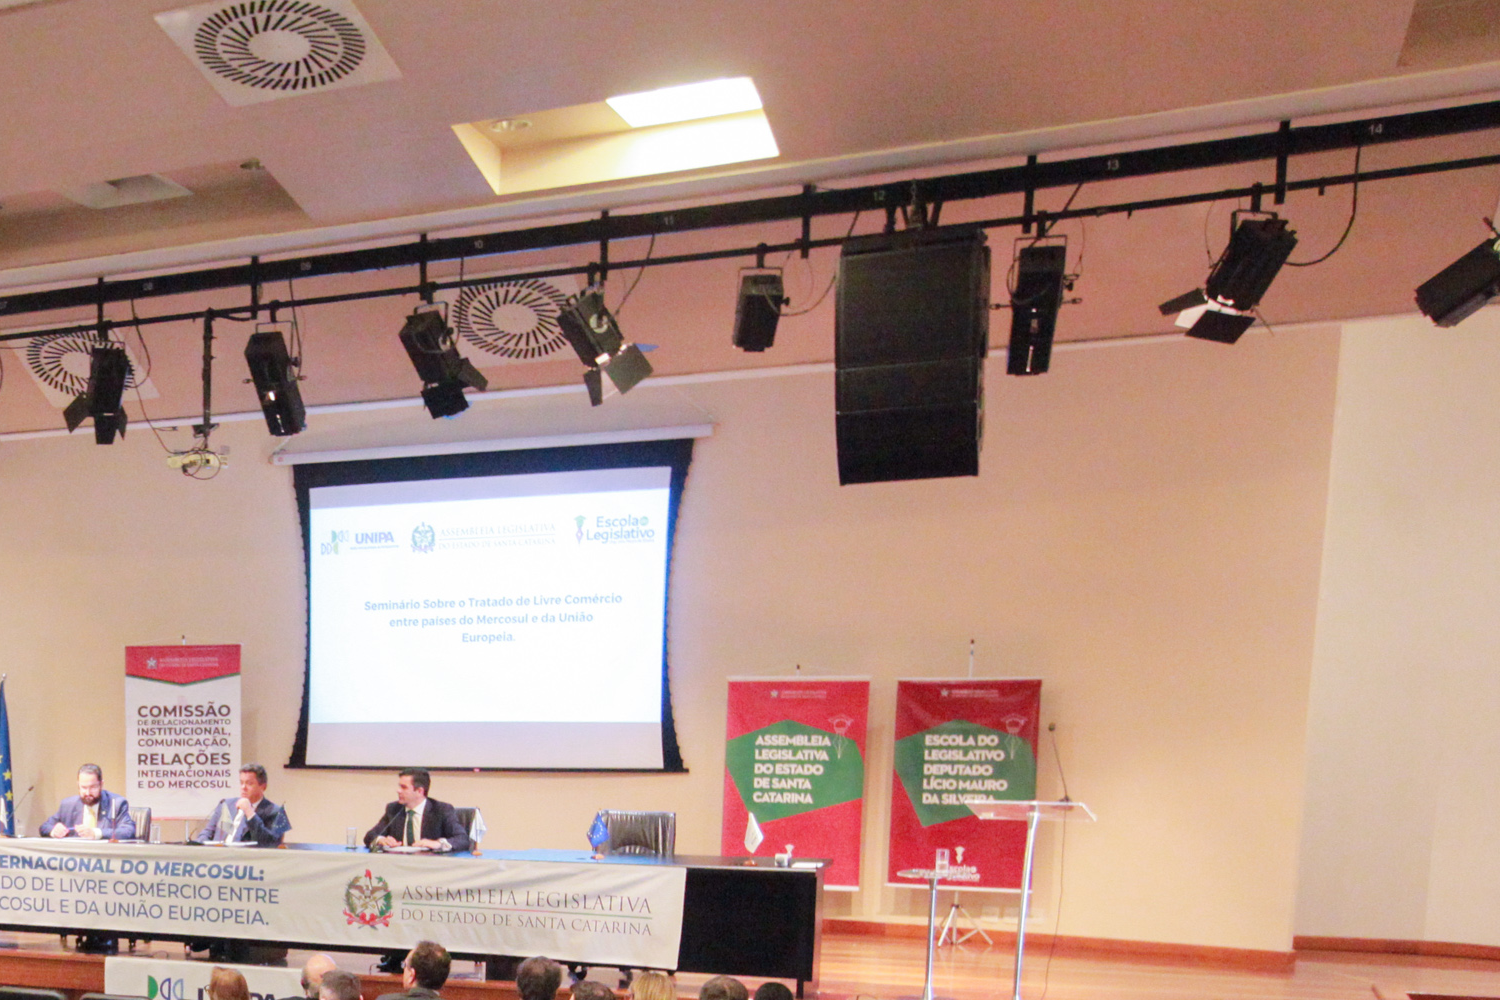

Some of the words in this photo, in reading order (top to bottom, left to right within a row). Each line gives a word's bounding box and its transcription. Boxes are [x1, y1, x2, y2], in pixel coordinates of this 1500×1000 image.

[1368, 123, 1383, 135] 14
[1107, 159, 1120, 170] 13
[873, 190, 886, 201] 12
[663, 216, 675, 226] 11
[474, 239, 485, 249] 10
[596, 514, 639, 528] Escola
[355, 531, 395, 544] UNIPA
[586, 527, 655, 544] Legislativo
[364, 599, 420, 611] Seminário
[423, 599, 456, 609] Sobre
[458, 600, 466, 608] o
[468, 596, 513, 608] Tratado
[515, 596, 531, 606] de
[533, 595, 562, 605] Livre
[564, 592, 623, 605] Comércio
[389, 617, 419, 627] entre
[421, 615, 457, 628] países
[459, 615, 474, 625] do
[476, 613, 528, 625] Mercosul
[531, 615, 539, 623] e
[541, 613, 556, 623] da
[559, 611, 594, 623] União
[462, 631, 516, 644] Europeia.
[137, 701, 231, 718] COMISSÃO
[137, 727, 231, 736] INSTITUCIONAL,
[137, 736, 231, 749] COMUNICAÇÃO,
[755, 734, 832, 747] ASSEMBLEIA
[925, 734, 976, 747] ESCOLA
[977, 734, 1000, 747] DO
[137, 749, 231, 769] RELAÇÕES
[754, 748, 830, 761] LEGISLATIVA
[924, 748, 1006, 762] LEGISLATIVO
[137, 769, 231, 778] INTERNACIONAIS
[754, 763, 774, 775] DO
[775, 763, 824, 776] ESTADO
[923, 763, 994, 776] DEPUTADO
[137, 780, 145, 789] E
[147, 780, 165, 789] DO
[168, 780, 231, 789] MERCOSUL
[753, 777, 770, 789] DE
[771, 777, 812, 790] SANTA
[923, 775, 957, 790] LÍCIO
[958, 779, 1009, 791] MAURO
[752, 791, 814, 804] CATARINA
[922, 792, 940, 804] DA
[120, 859, 148, 875] DO
[153, 861, 264, 881] MERCOSUL:
[31, 877, 55, 892] DE
[60, 878, 108, 895] LIVRE
[113, 880, 212, 900] COMÉRCIO
[218, 886, 279, 904] ENTRE
[401, 885, 517, 906] ASSEMBLEIA
[525, 890, 652, 914] LEGISLATIVA
[60, 899, 70, 913] E
[75, 900, 100, 916] DA
[105, 901, 163, 919] UNIÃO
[168, 905, 269, 926] EUROPEIA.
[401, 908, 424, 921] DO
[429, 910, 487, 925] ESTADO
[492, 912, 512, 926] DE
[518, 914, 566, 931] SANTA
[571, 918, 652, 936] CATARINA
